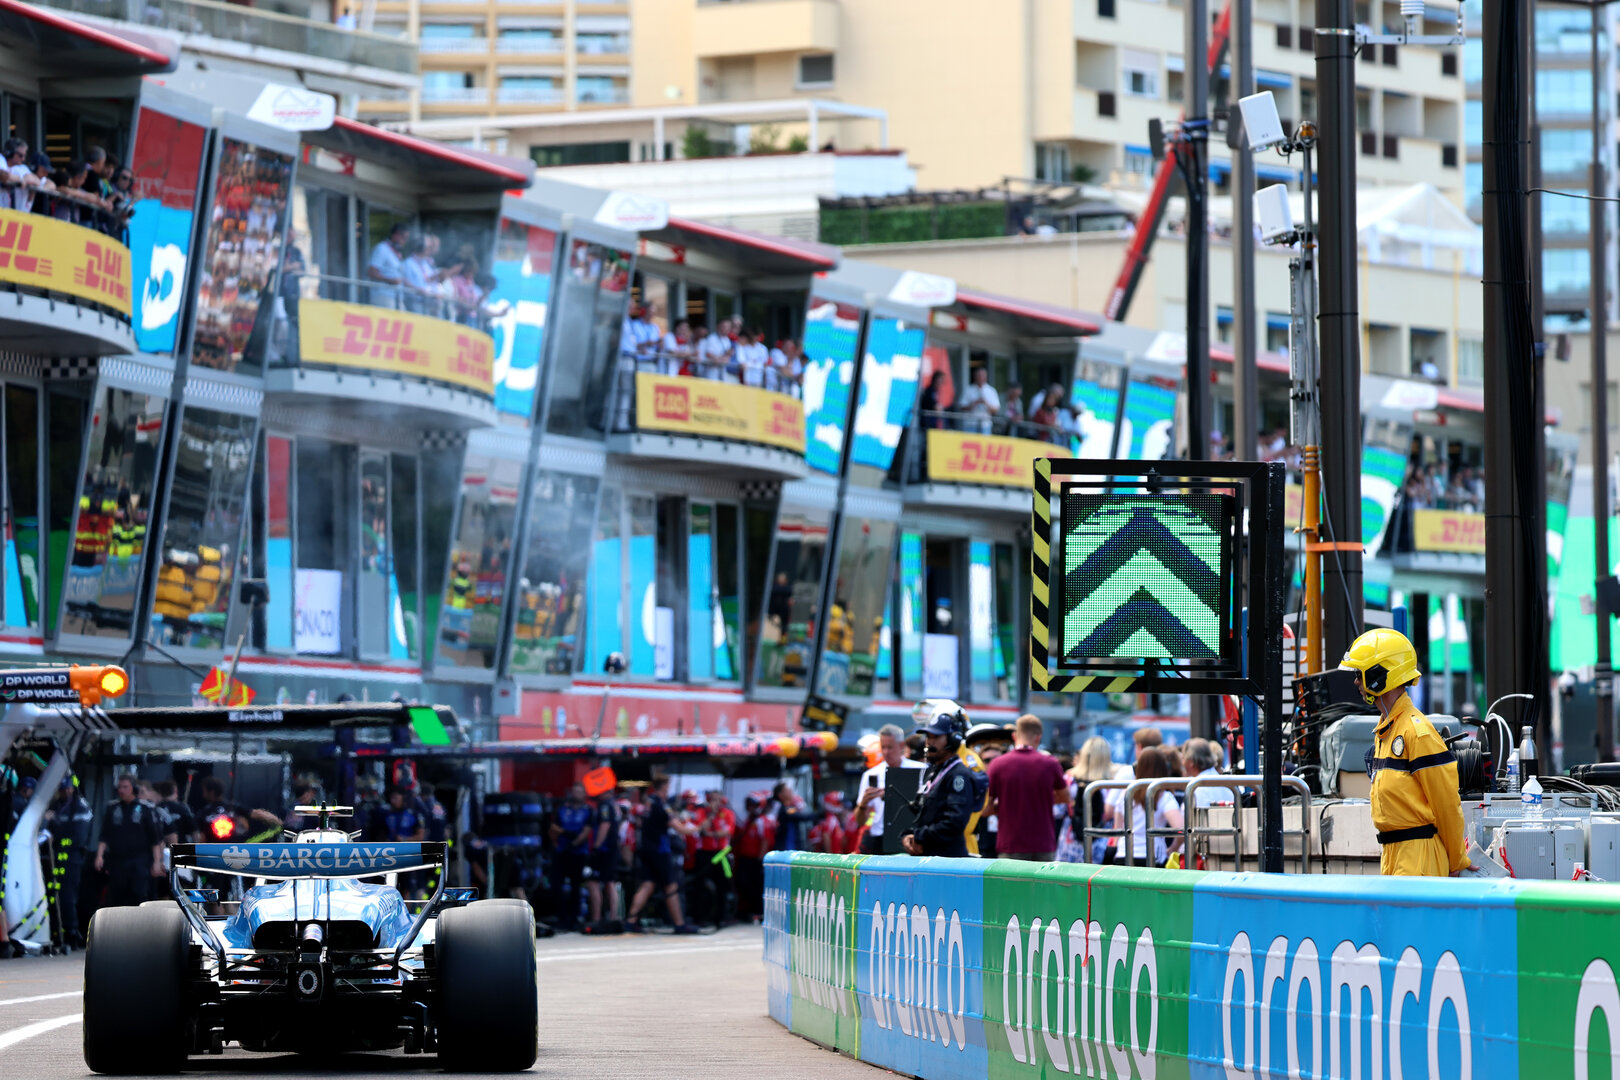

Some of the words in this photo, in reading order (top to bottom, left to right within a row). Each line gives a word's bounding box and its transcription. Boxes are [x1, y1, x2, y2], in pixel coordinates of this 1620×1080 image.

[0, 219, 38, 272] HL
[85, 240, 124, 300] DHL
[342, 313, 418, 363] DHL
[961, 442, 1014, 474] DHL
[5, 676, 22, 686] DP
[23, 674, 67, 685] WORLD
[17, 689, 33, 699] DP
[258, 846, 397, 870] BARCLAYS
[869, 899, 966, 1052] aramco
[1002, 912, 1159, 1080] aramco
[1222, 930, 1473, 1080] aramco
